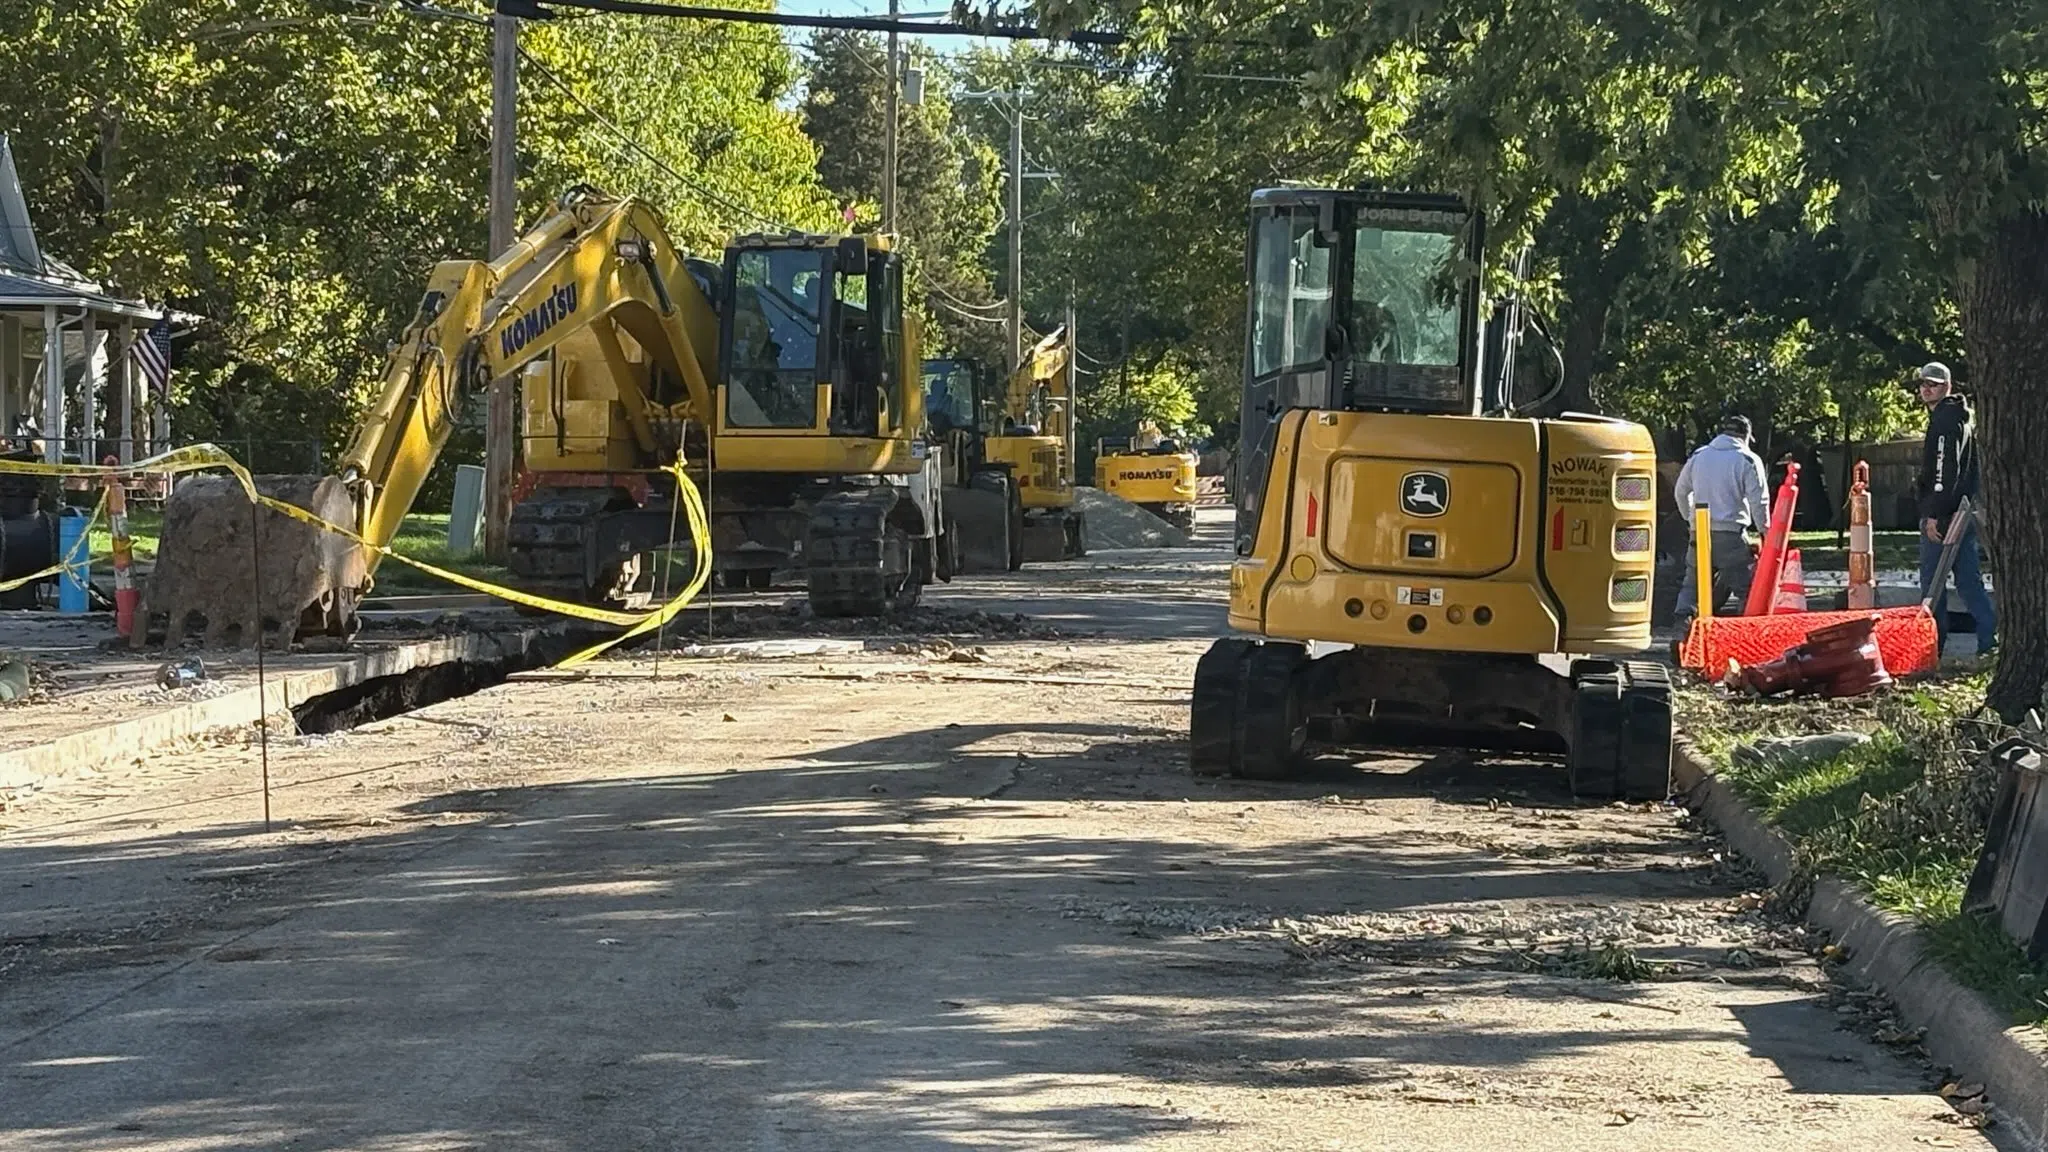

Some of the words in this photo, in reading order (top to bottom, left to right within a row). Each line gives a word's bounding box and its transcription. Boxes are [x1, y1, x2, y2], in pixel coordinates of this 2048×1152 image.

[1357, 206, 1405, 221] JOHN
[1407, 208, 1467, 225] DEERE
[500, 281, 578, 361] KOMATSU
[1119, 468, 1174, 481] KOMATSU
[1551, 457, 1608, 477] NOWAK
